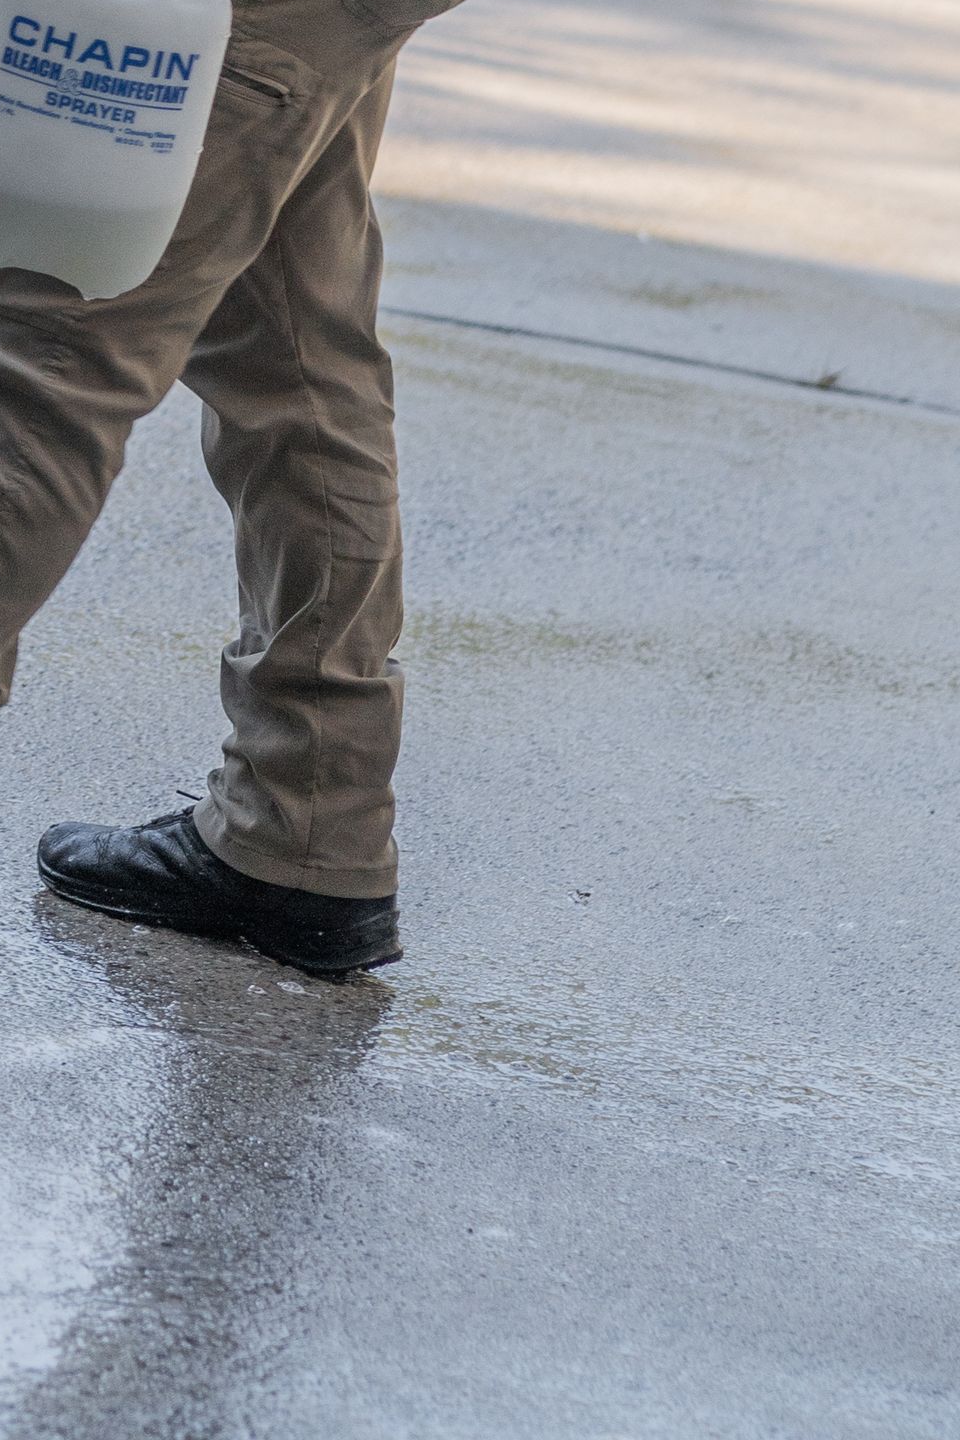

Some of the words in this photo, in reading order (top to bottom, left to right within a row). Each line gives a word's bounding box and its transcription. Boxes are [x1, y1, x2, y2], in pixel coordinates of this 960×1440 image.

[2, 46, 63, 81] BLEACH
[80, 71, 189, 105] DISINFECTANT
[9, 15, 196, 81] CHAPIN
[45, 91, 136, 124] SPRAYER
